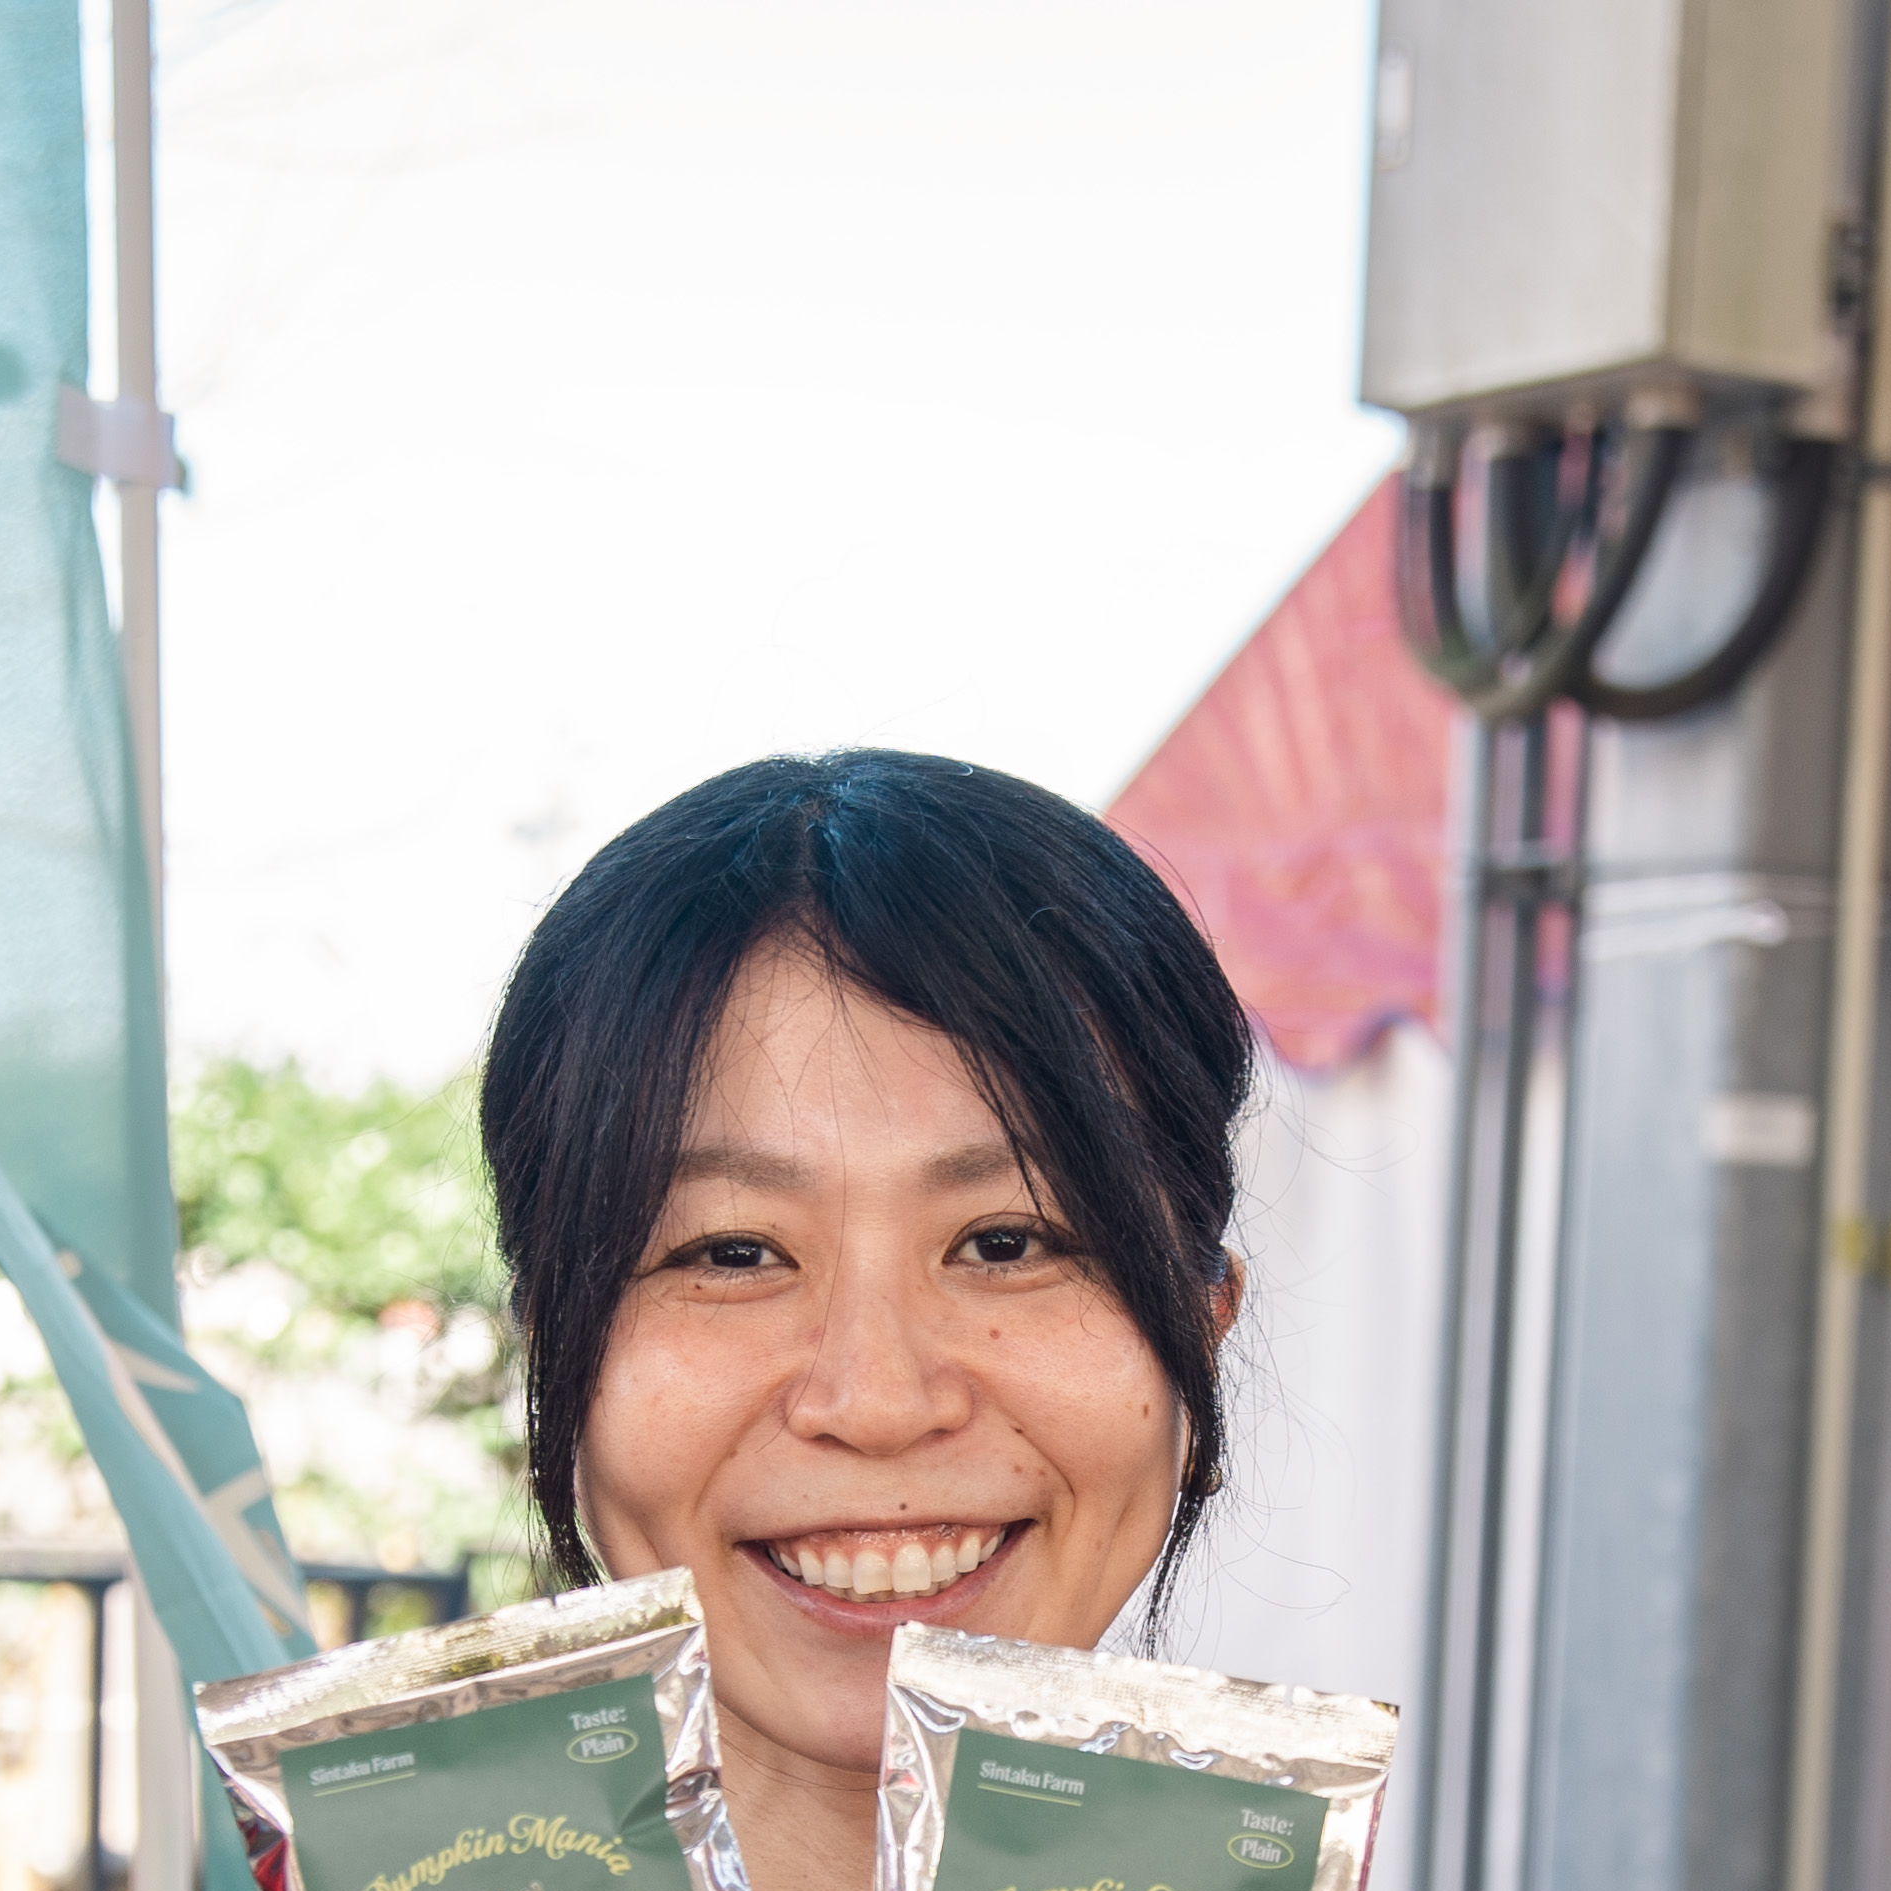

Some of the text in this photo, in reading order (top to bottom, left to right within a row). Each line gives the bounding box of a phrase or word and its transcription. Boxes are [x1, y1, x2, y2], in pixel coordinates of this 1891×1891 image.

[567, 1706, 628, 1731] Taste:
[580, 1733, 625, 1758] Plain
[370, 1751, 415, 1773] Farm
[979, 1760, 1085, 1796] Sintaku Farm
[1241, 1807, 1294, 1837] Taste:
[508, 1813, 632, 1877] Mania
[1240, 1837, 1283, 1863] Plain
